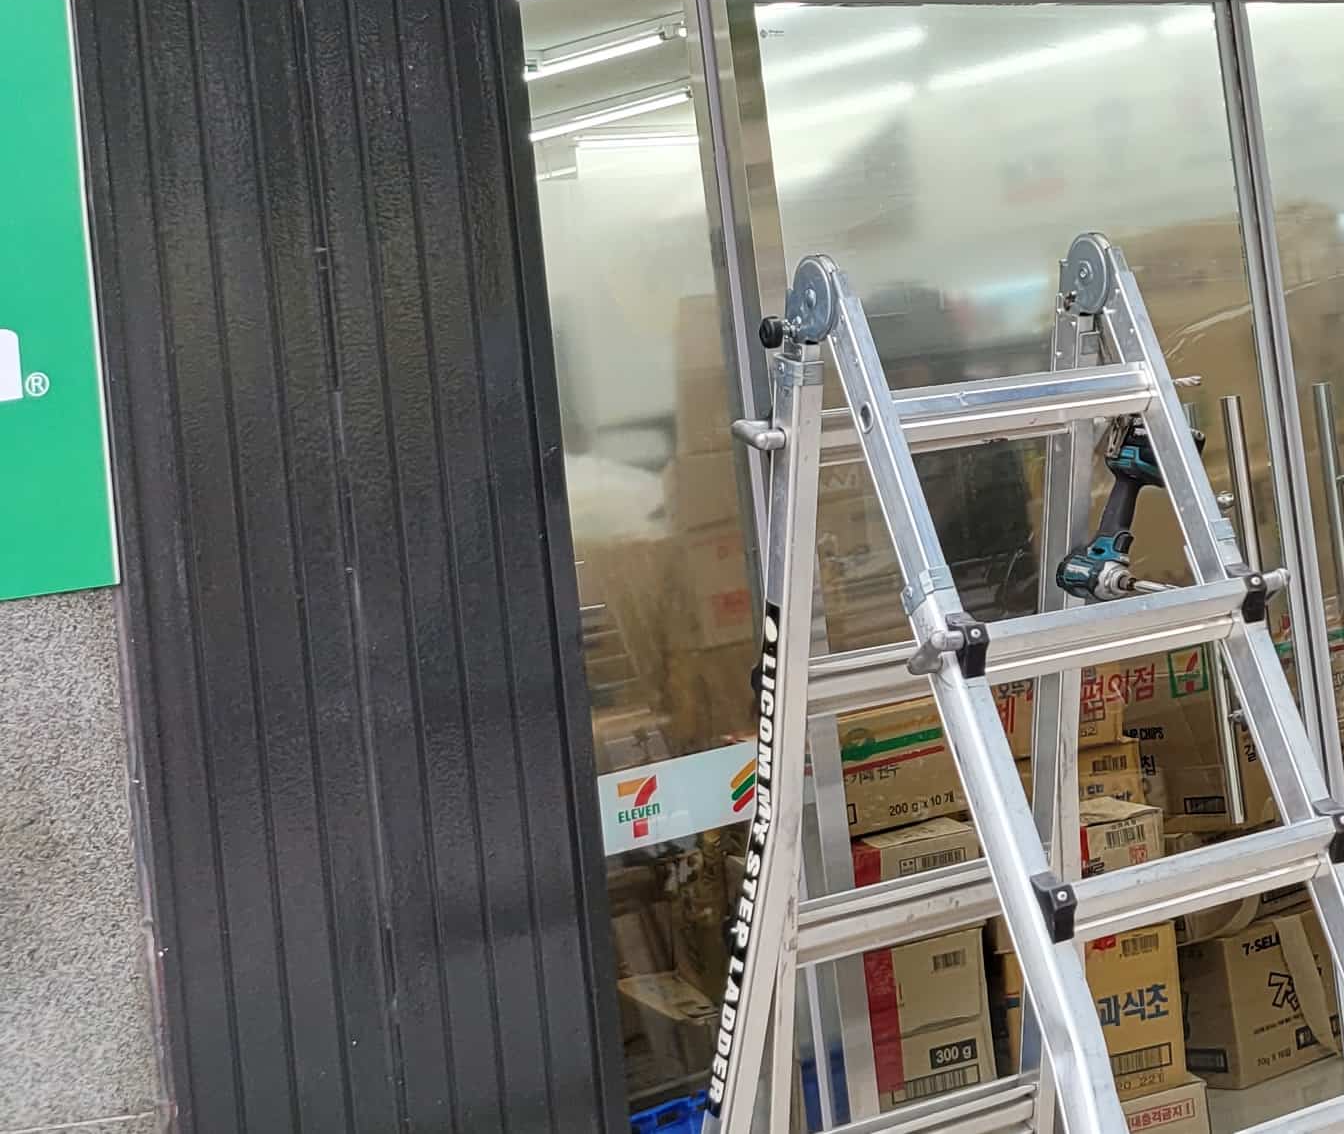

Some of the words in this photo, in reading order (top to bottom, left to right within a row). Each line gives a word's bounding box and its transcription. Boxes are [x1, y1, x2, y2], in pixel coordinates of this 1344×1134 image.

[889, 802, 909, 817] 200
[930, 794, 942, 807] 10
[708, 955, 744, 1104] LADDER
[935, 1044, 960, 1064] 300
[962, 1046, 972, 1061] g
